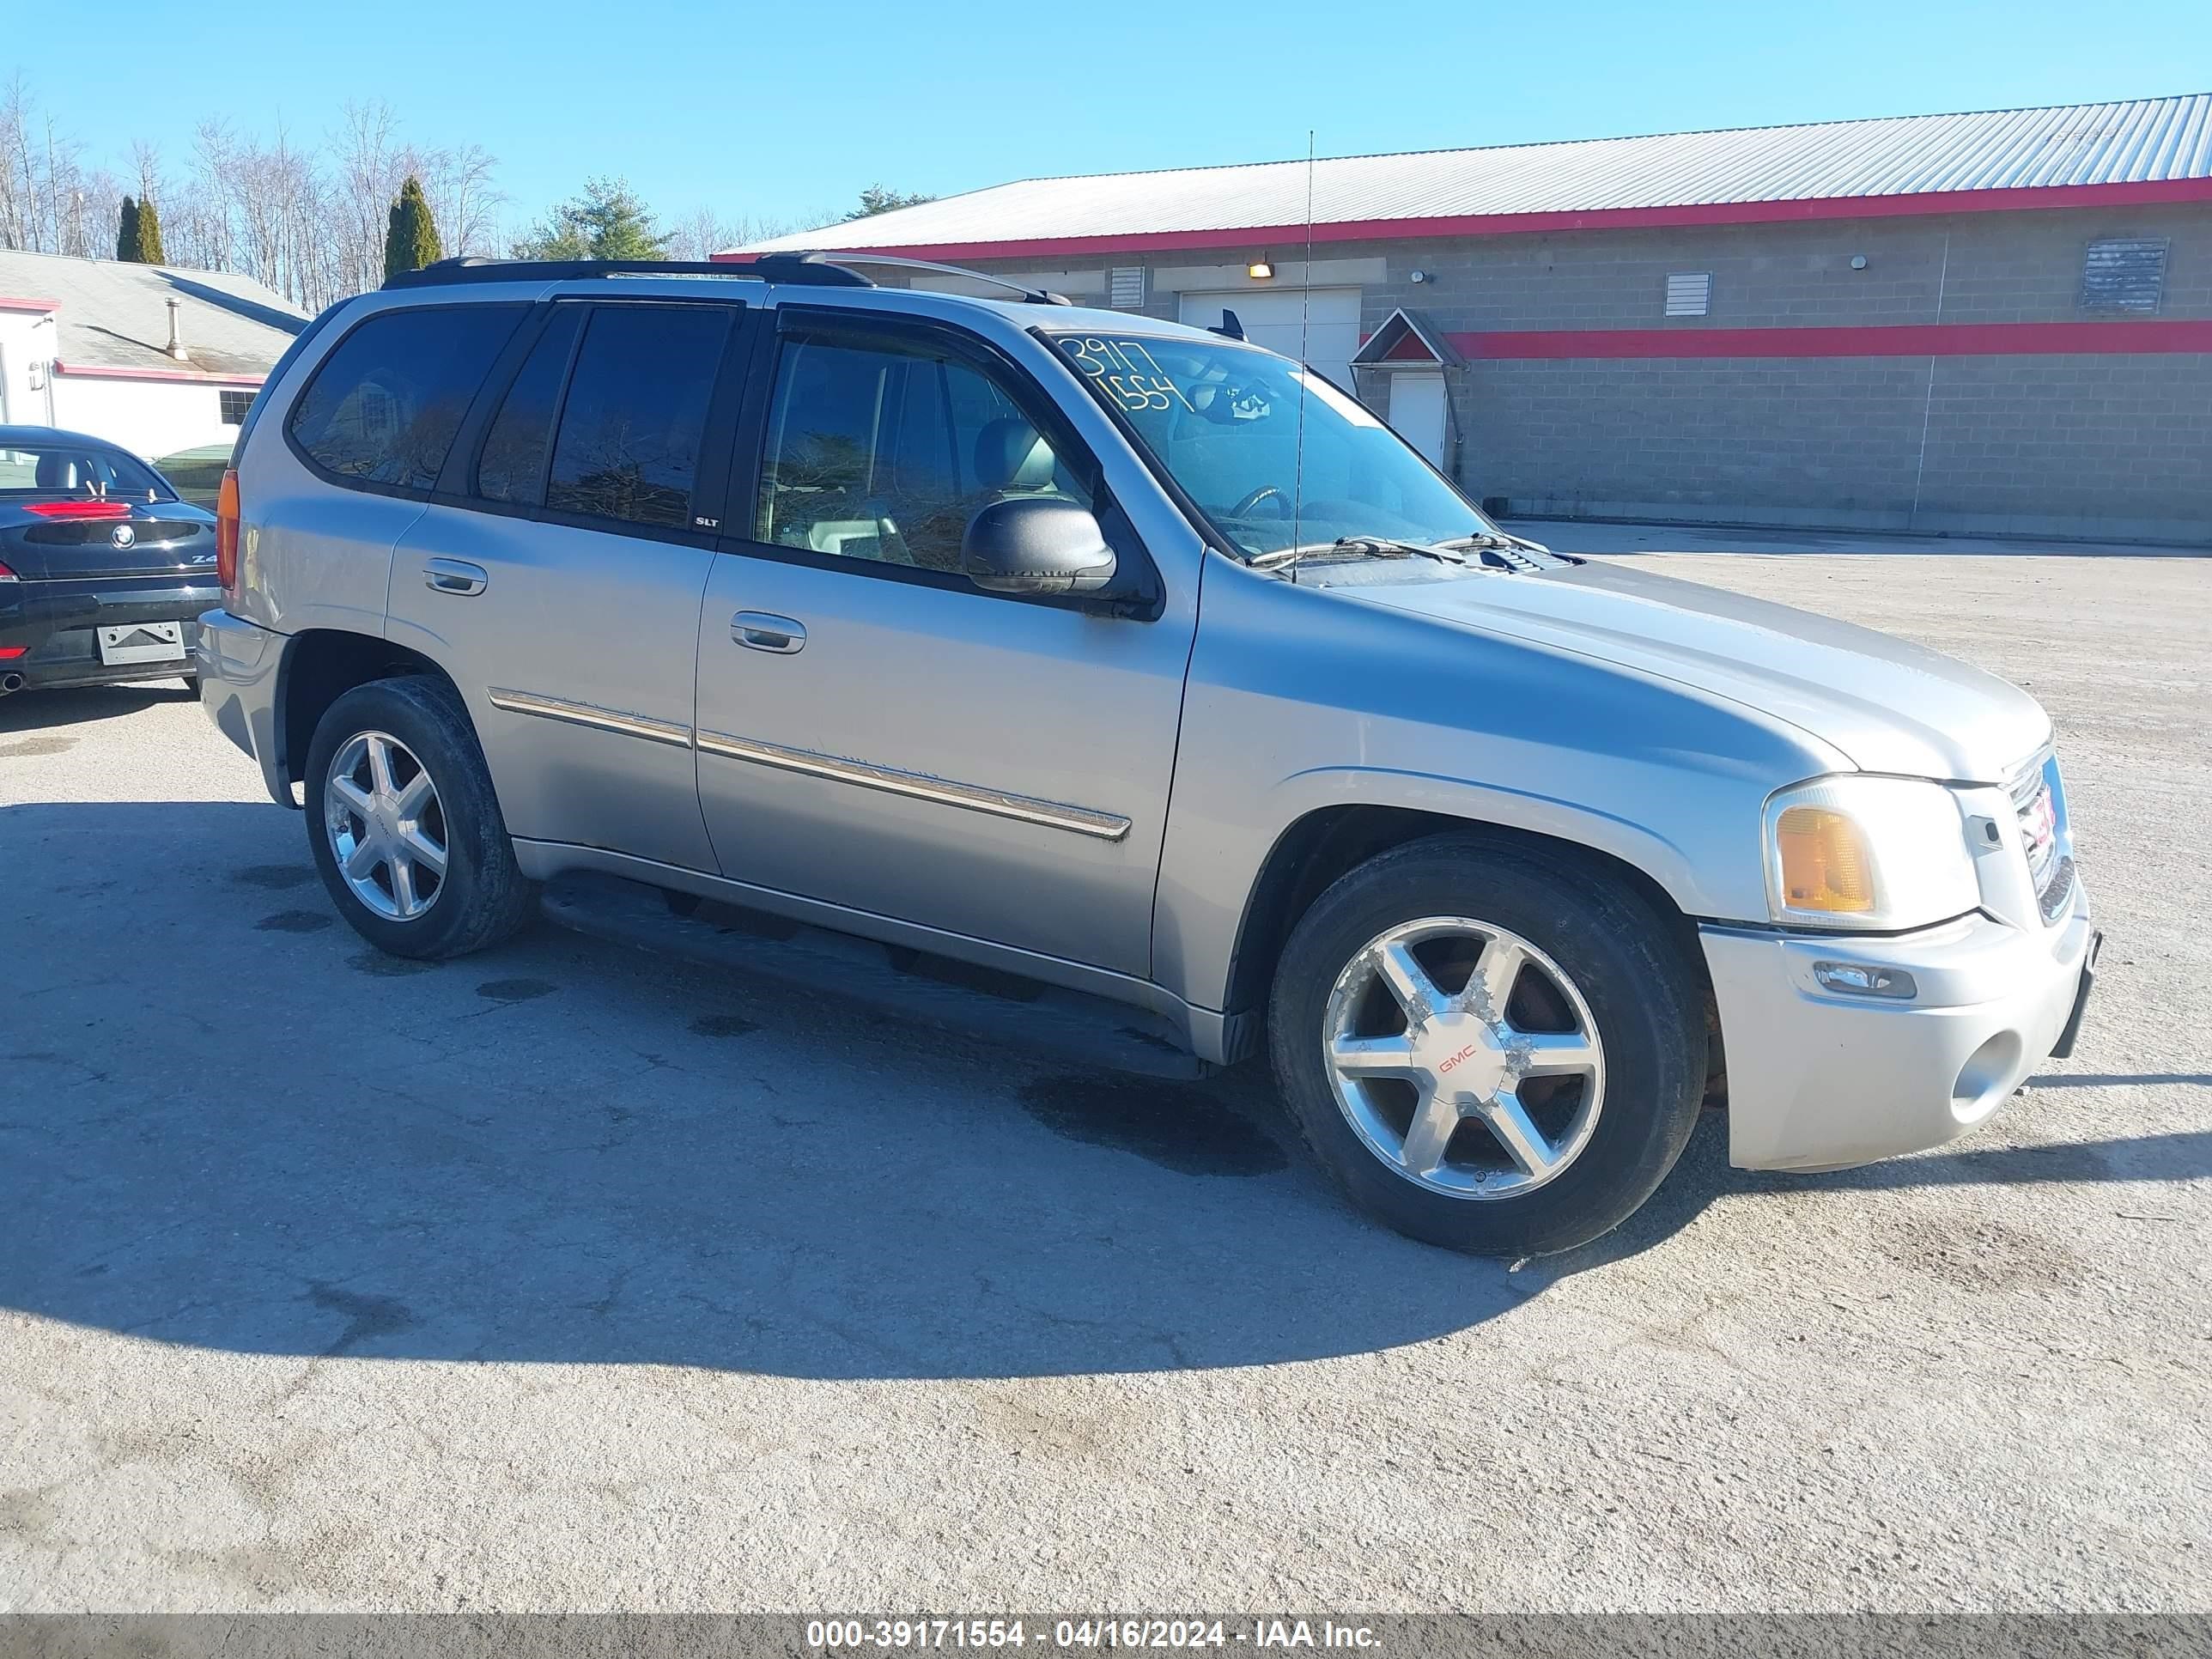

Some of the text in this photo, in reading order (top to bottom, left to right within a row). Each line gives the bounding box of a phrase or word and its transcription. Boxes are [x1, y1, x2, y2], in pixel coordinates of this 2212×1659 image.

[1058, 338, 1163, 376] 3917
[1096, 374, 1194, 413] 1554
[696, 517, 719, 527] SLT
[191, 555, 217, 563] Z4
[1439, 1044, 1476, 1073] GMC
